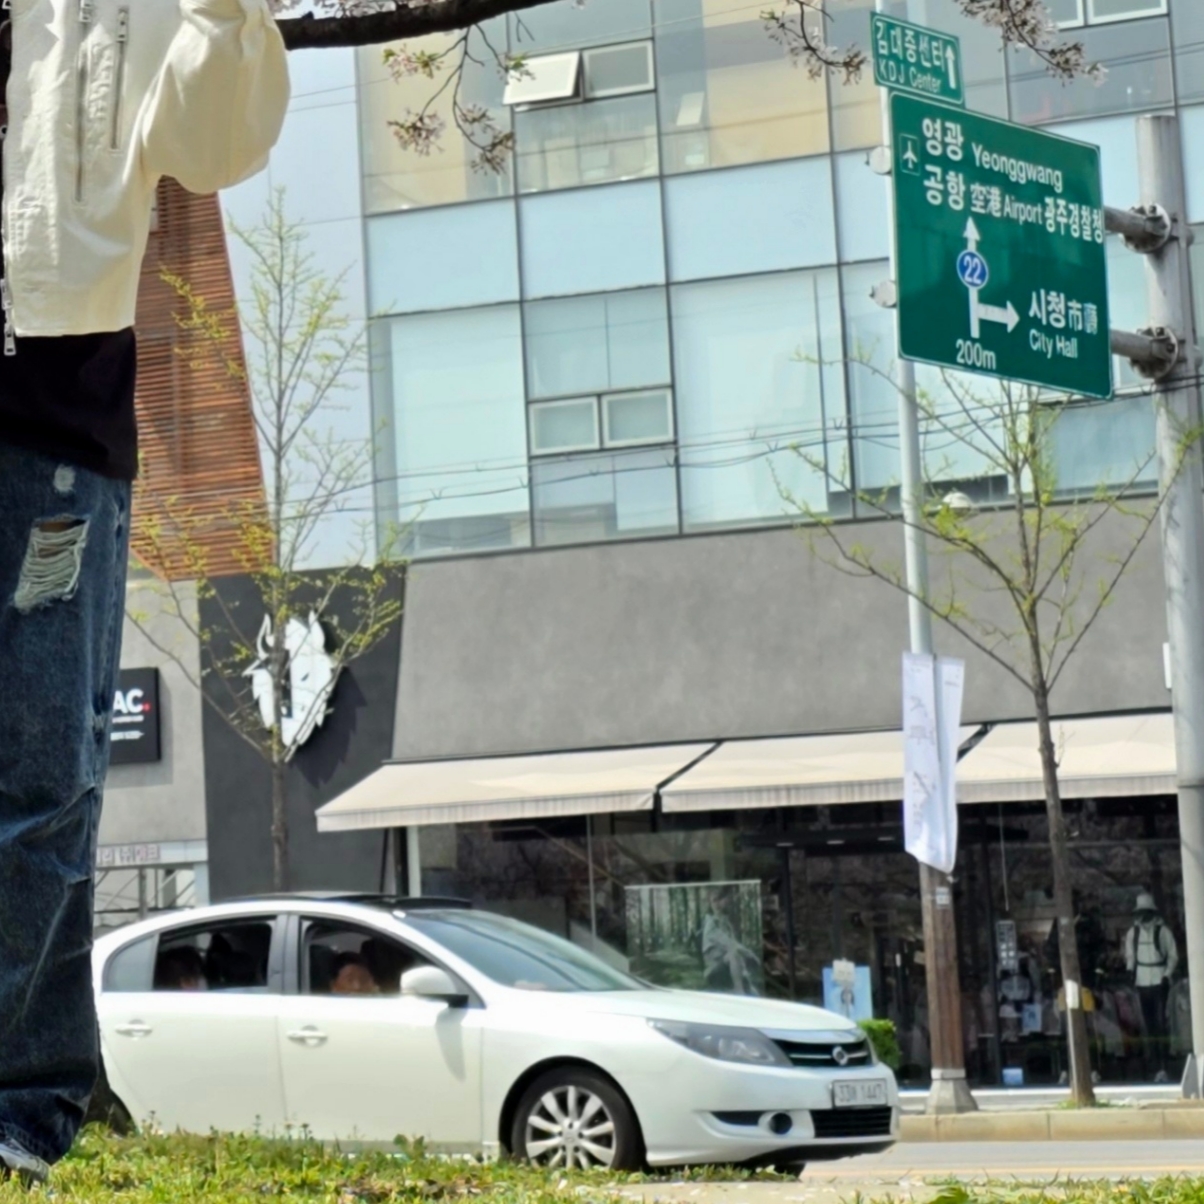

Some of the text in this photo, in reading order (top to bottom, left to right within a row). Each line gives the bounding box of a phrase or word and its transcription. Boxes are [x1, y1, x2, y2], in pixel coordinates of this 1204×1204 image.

[875, 21, 946, 72] 김대중센터
[878, 59, 942, 92] KDJ Center
[922, 117, 1063, 193] 영광 Yeonggwang
[923, 163, 1104, 244] 공항 空港 Airport 광주경찰청
[962, 255, 983, 286] 22
[1028, 288, 1068, 330] 시청
[956, 338, 996, 370] 200m
[1029, 331, 1079, 359] City Hall
